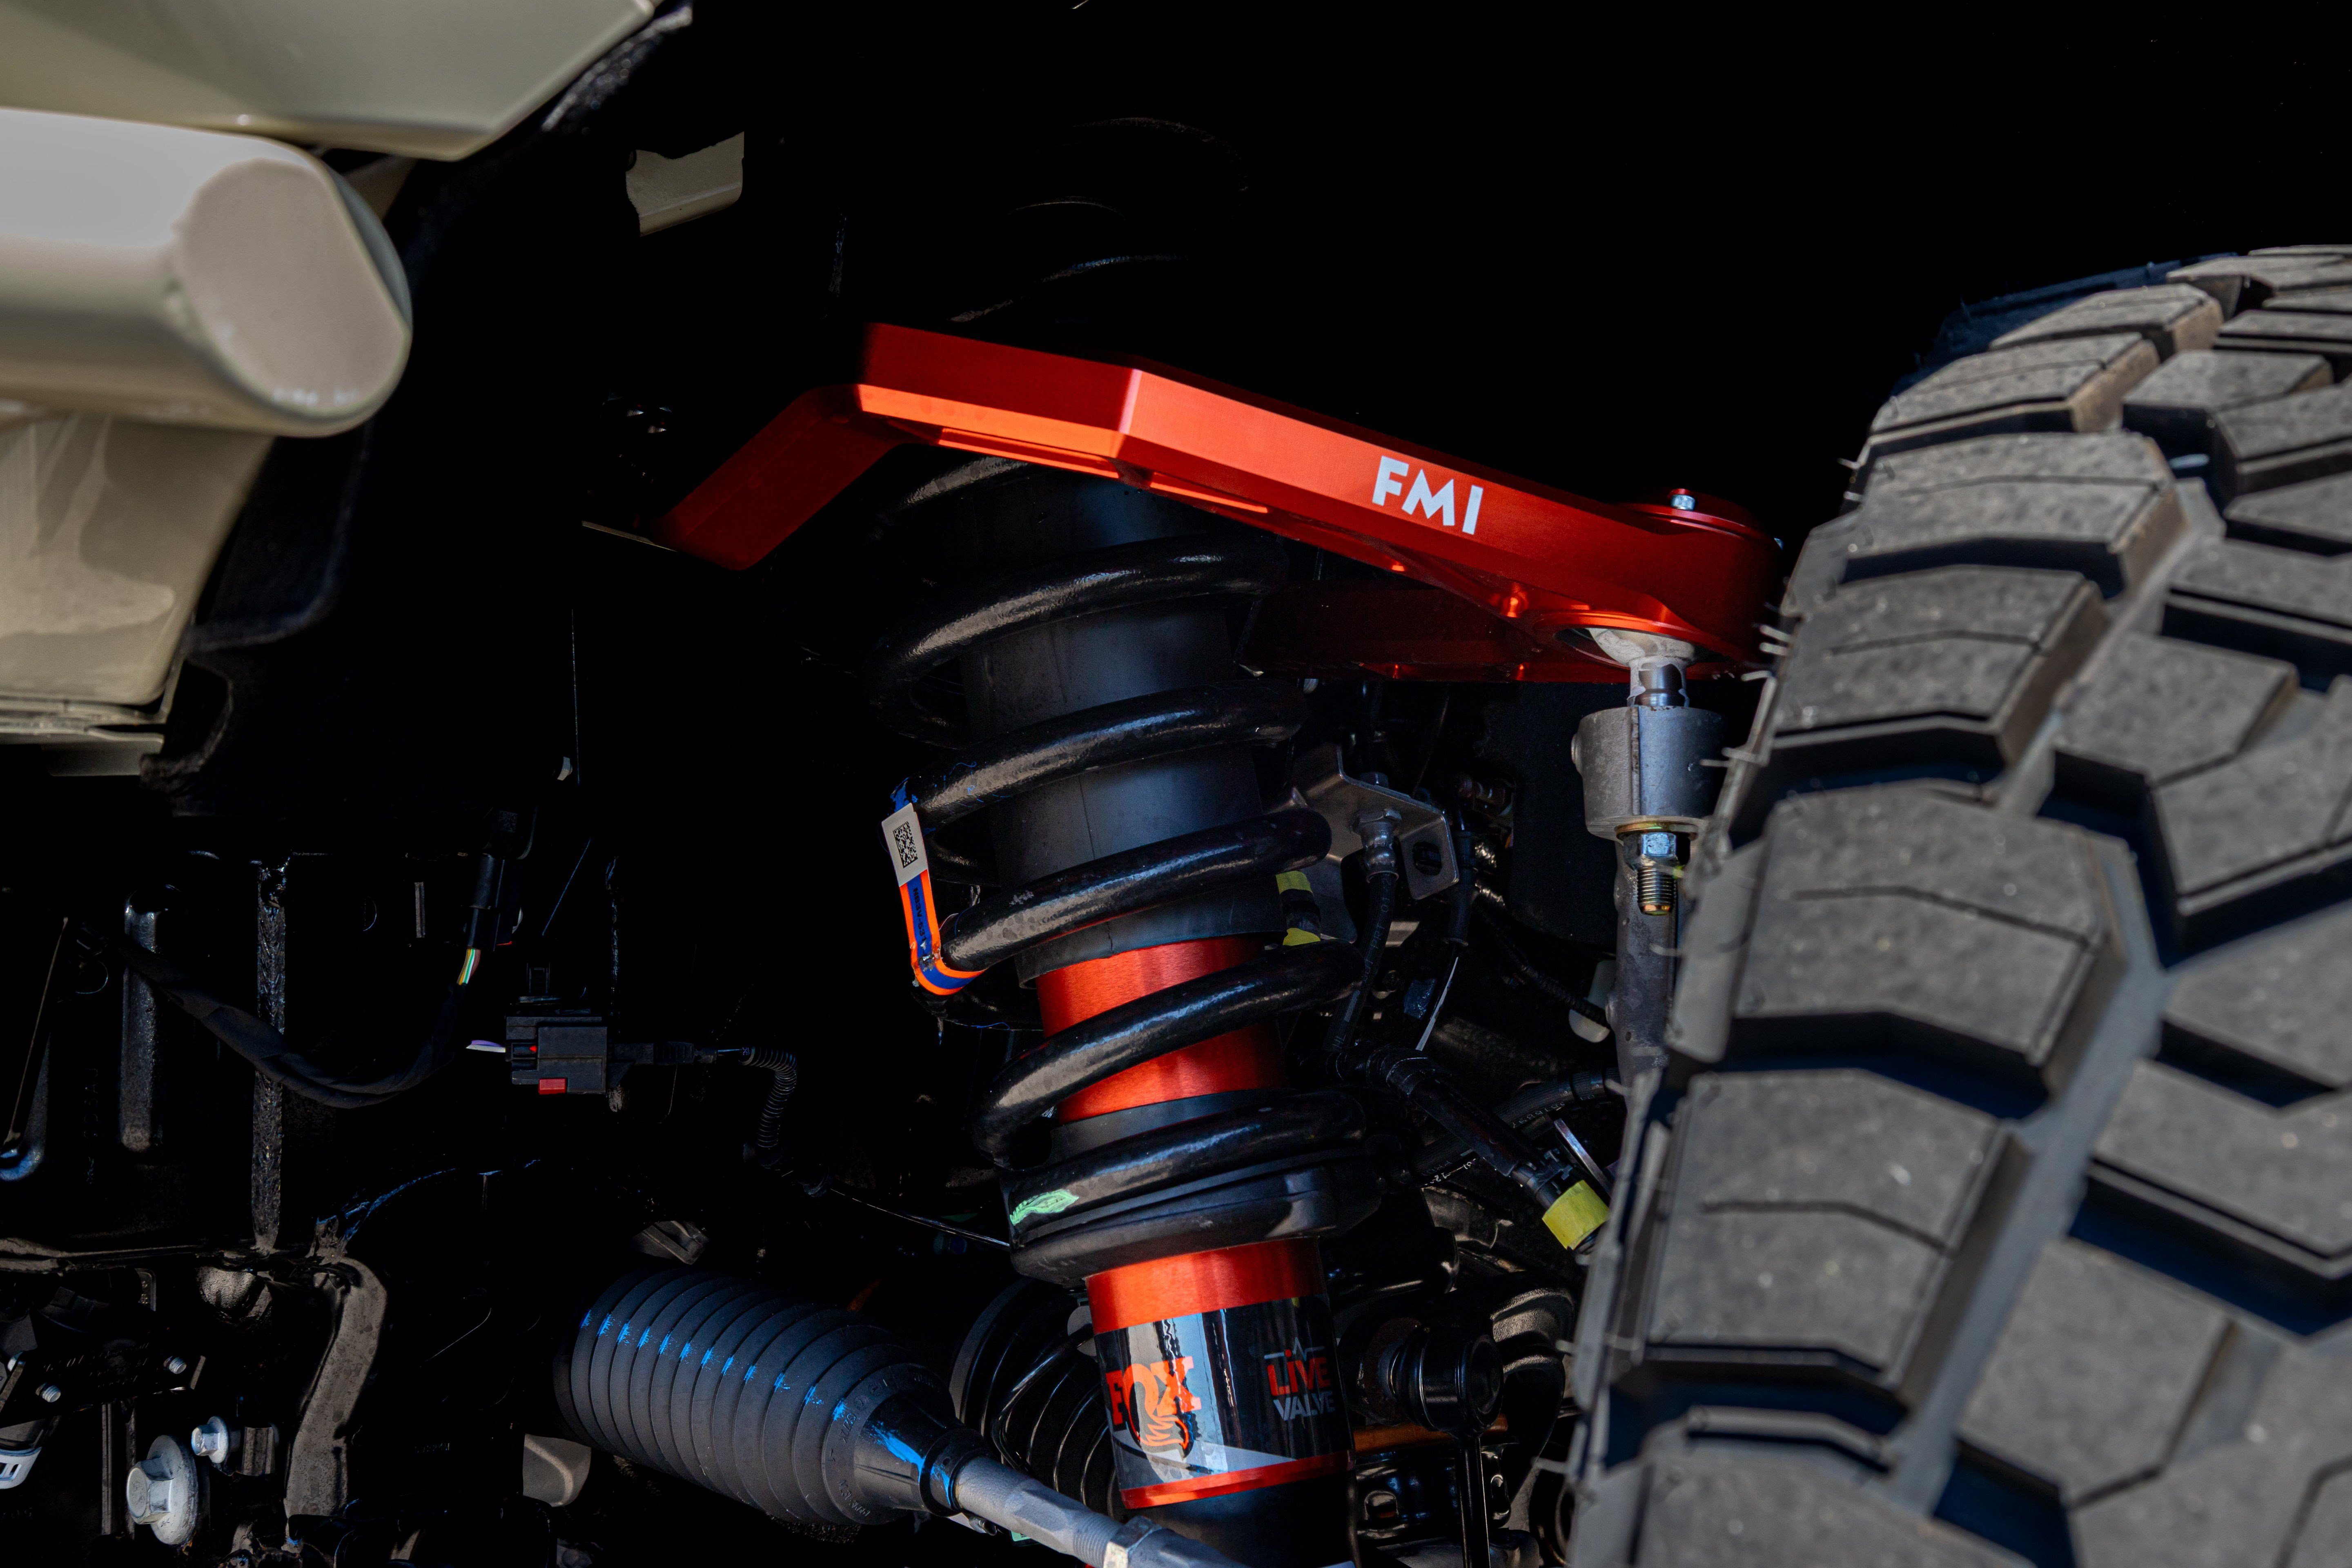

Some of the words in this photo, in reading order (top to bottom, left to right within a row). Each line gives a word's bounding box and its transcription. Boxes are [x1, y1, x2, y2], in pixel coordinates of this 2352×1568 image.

[1372, 455, 1483, 535] FMI
[1105, 1356, 1202, 1449] FOX
[1273, 1390, 1336, 1421] VALVE
